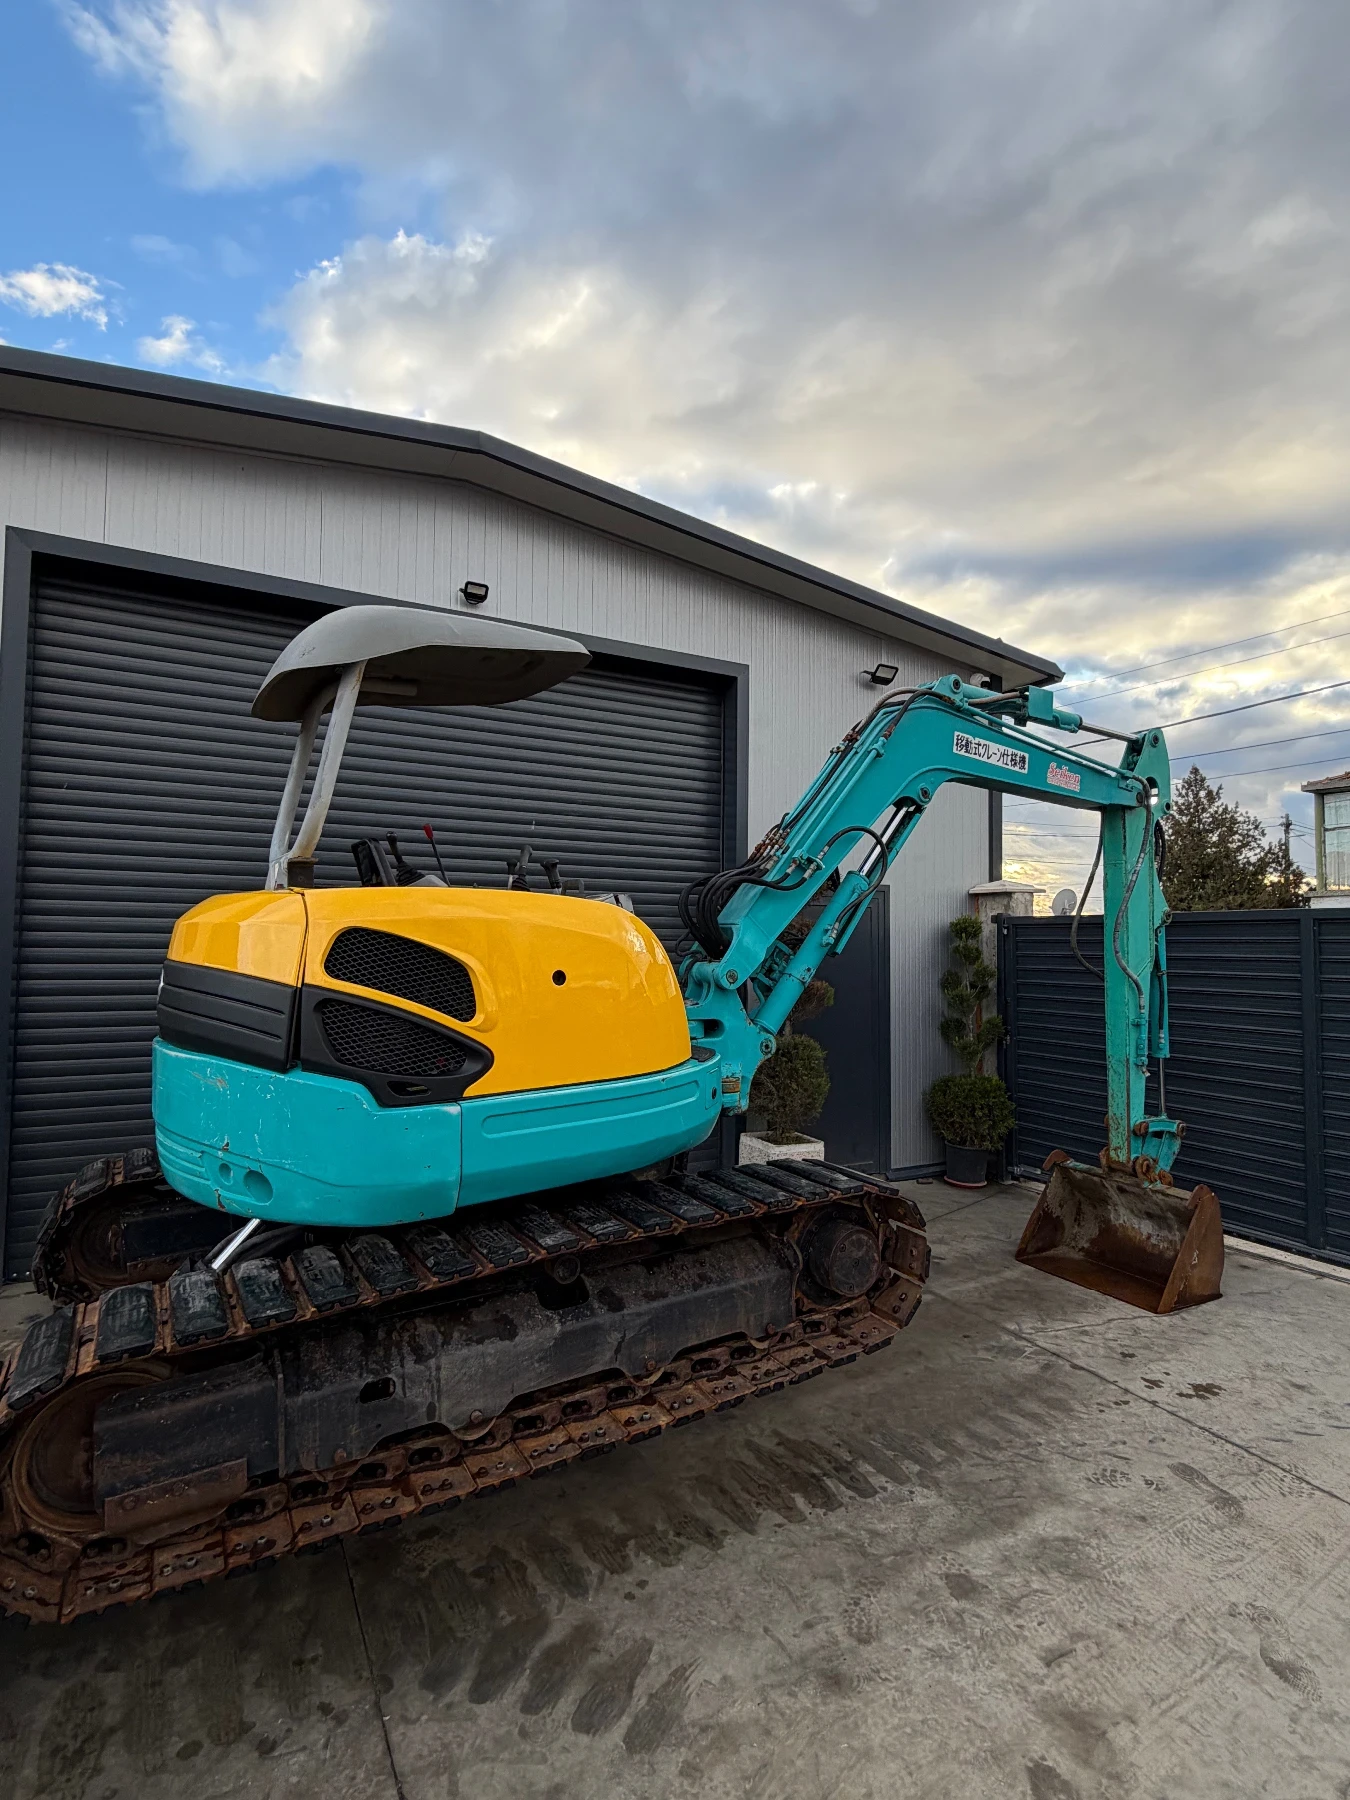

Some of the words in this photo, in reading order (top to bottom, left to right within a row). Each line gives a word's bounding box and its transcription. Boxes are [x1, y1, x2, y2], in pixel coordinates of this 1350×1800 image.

[955, 734, 1027, 771] 移動式クレーン仕様機
